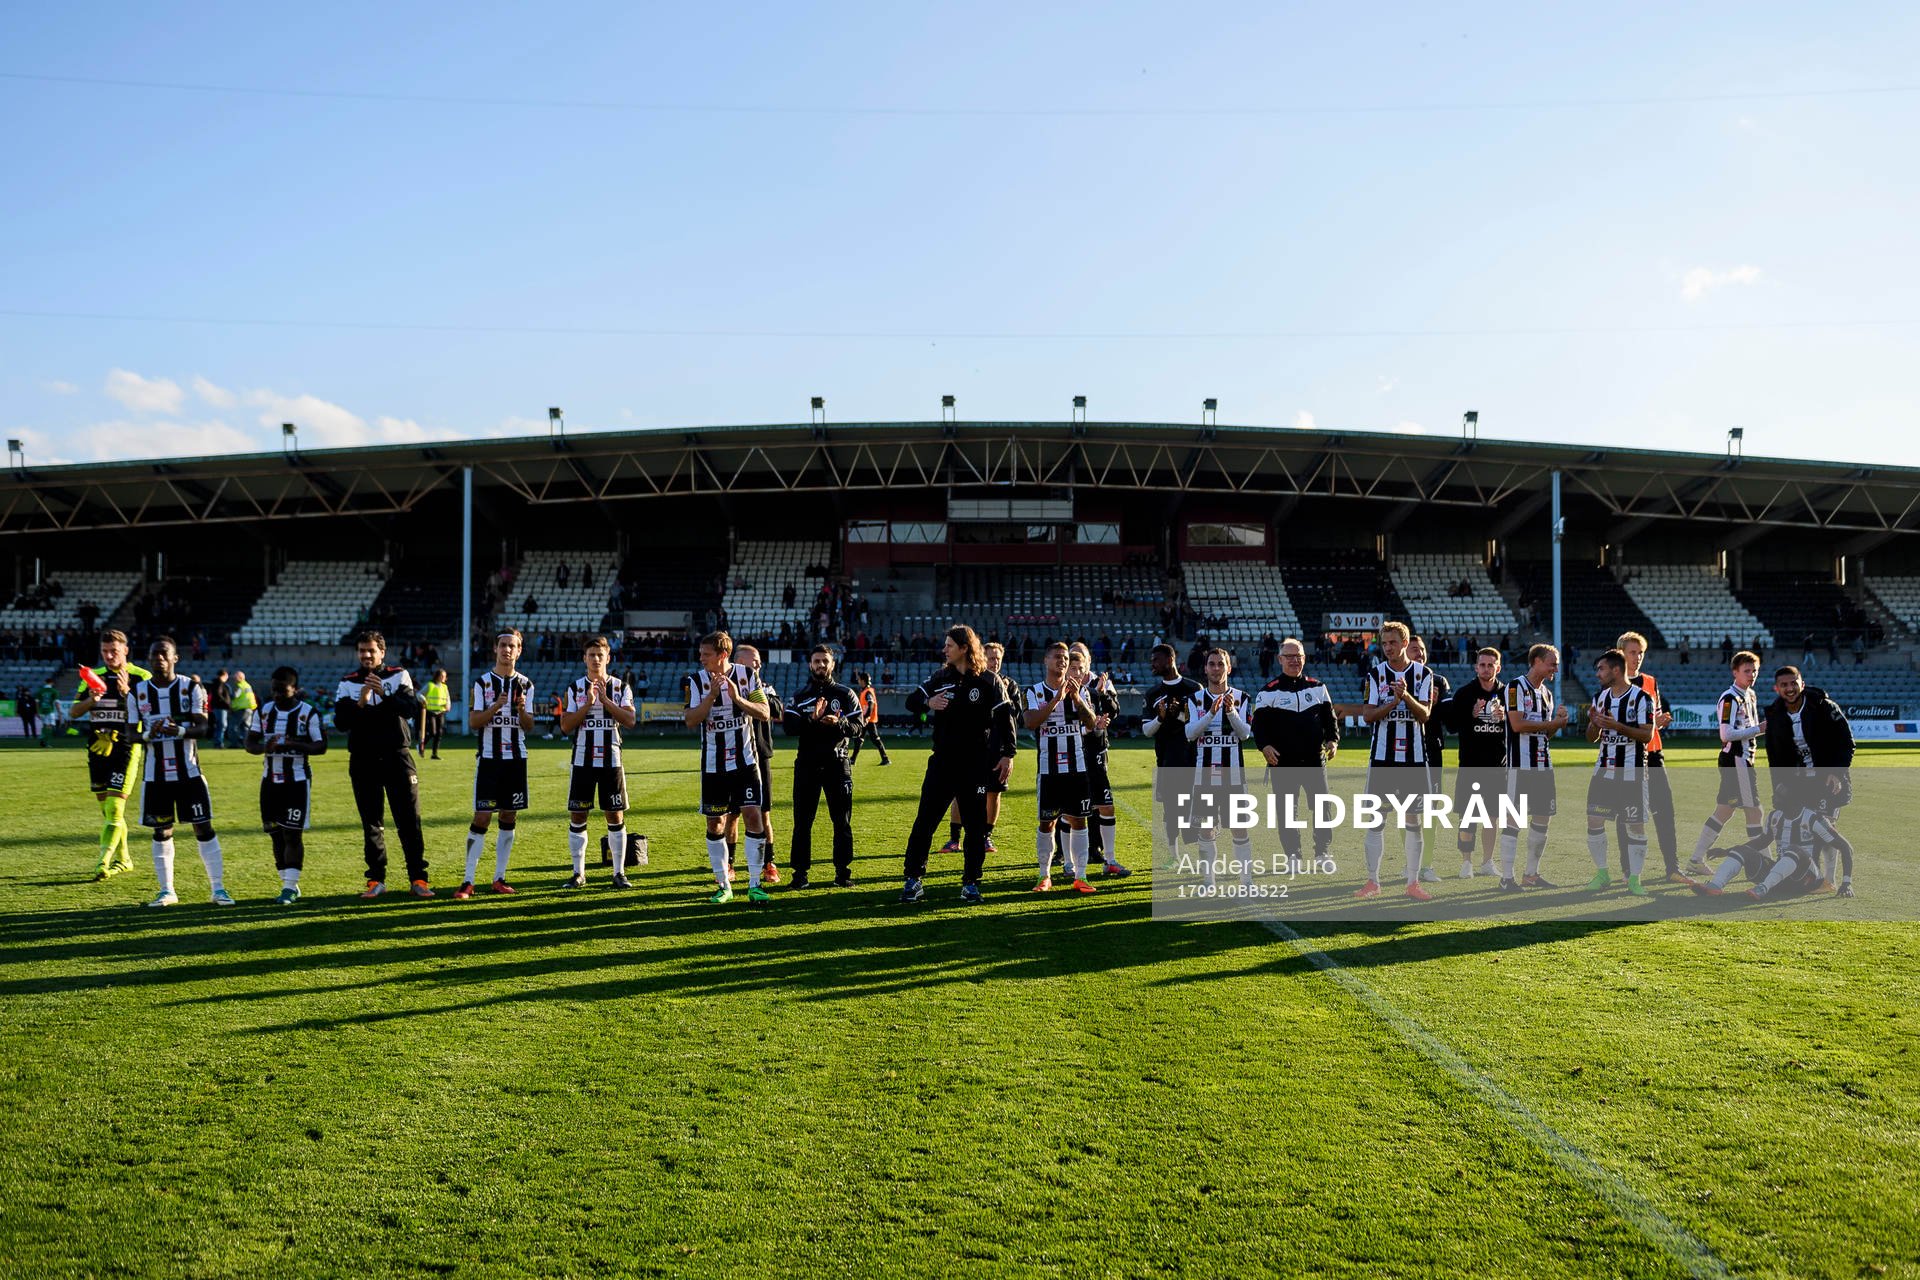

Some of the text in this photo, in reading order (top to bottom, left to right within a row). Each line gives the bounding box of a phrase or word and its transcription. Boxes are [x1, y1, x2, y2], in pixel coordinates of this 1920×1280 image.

[1346, 617, 1367, 626] VIP
[1847, 705, 1896, 716] Conditori
[1041, 725, 1079, 735] MOBILL
[111, 772, 124, 784] 29
[512, 792, 524, 804] 22
[745, 787, 754, 799] 6
[610, 794, 623, 806] 18
[1081, 799, 1091, 811] 17
[1819, 799, 1827, 810] 3
[192, 803, 204, 816] 11
[287, 808, 301, 821] 19
[1625, 806, 1638, 818] 12
